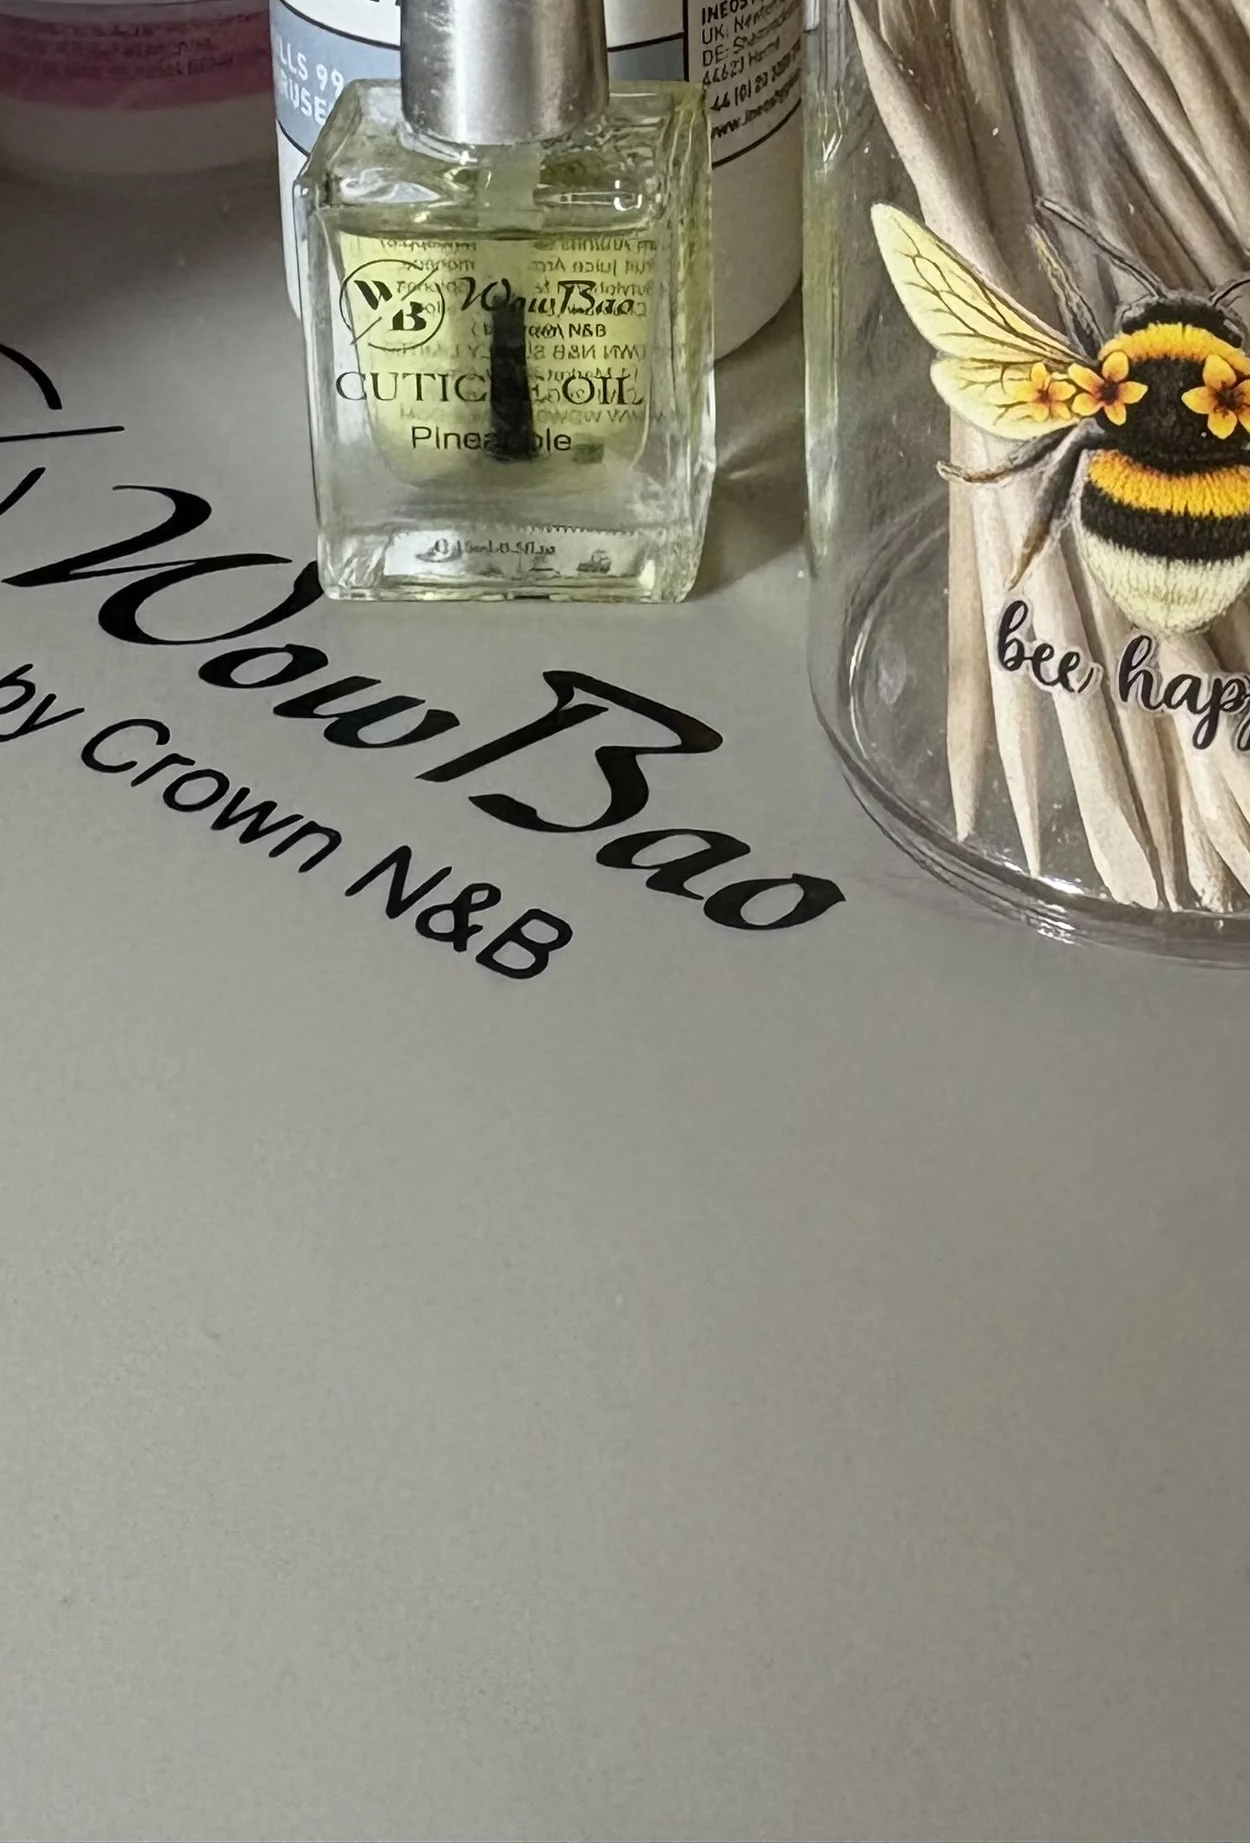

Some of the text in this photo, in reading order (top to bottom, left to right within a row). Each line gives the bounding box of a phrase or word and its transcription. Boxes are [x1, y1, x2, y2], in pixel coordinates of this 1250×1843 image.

[569, 324, 607, 338] N&B
[561, 375, 646, 406] OIL
[998, 600, 1093, 694] bee
[81, 719, 343, 874] Crown
[344, 846, 574, 981] N&B
